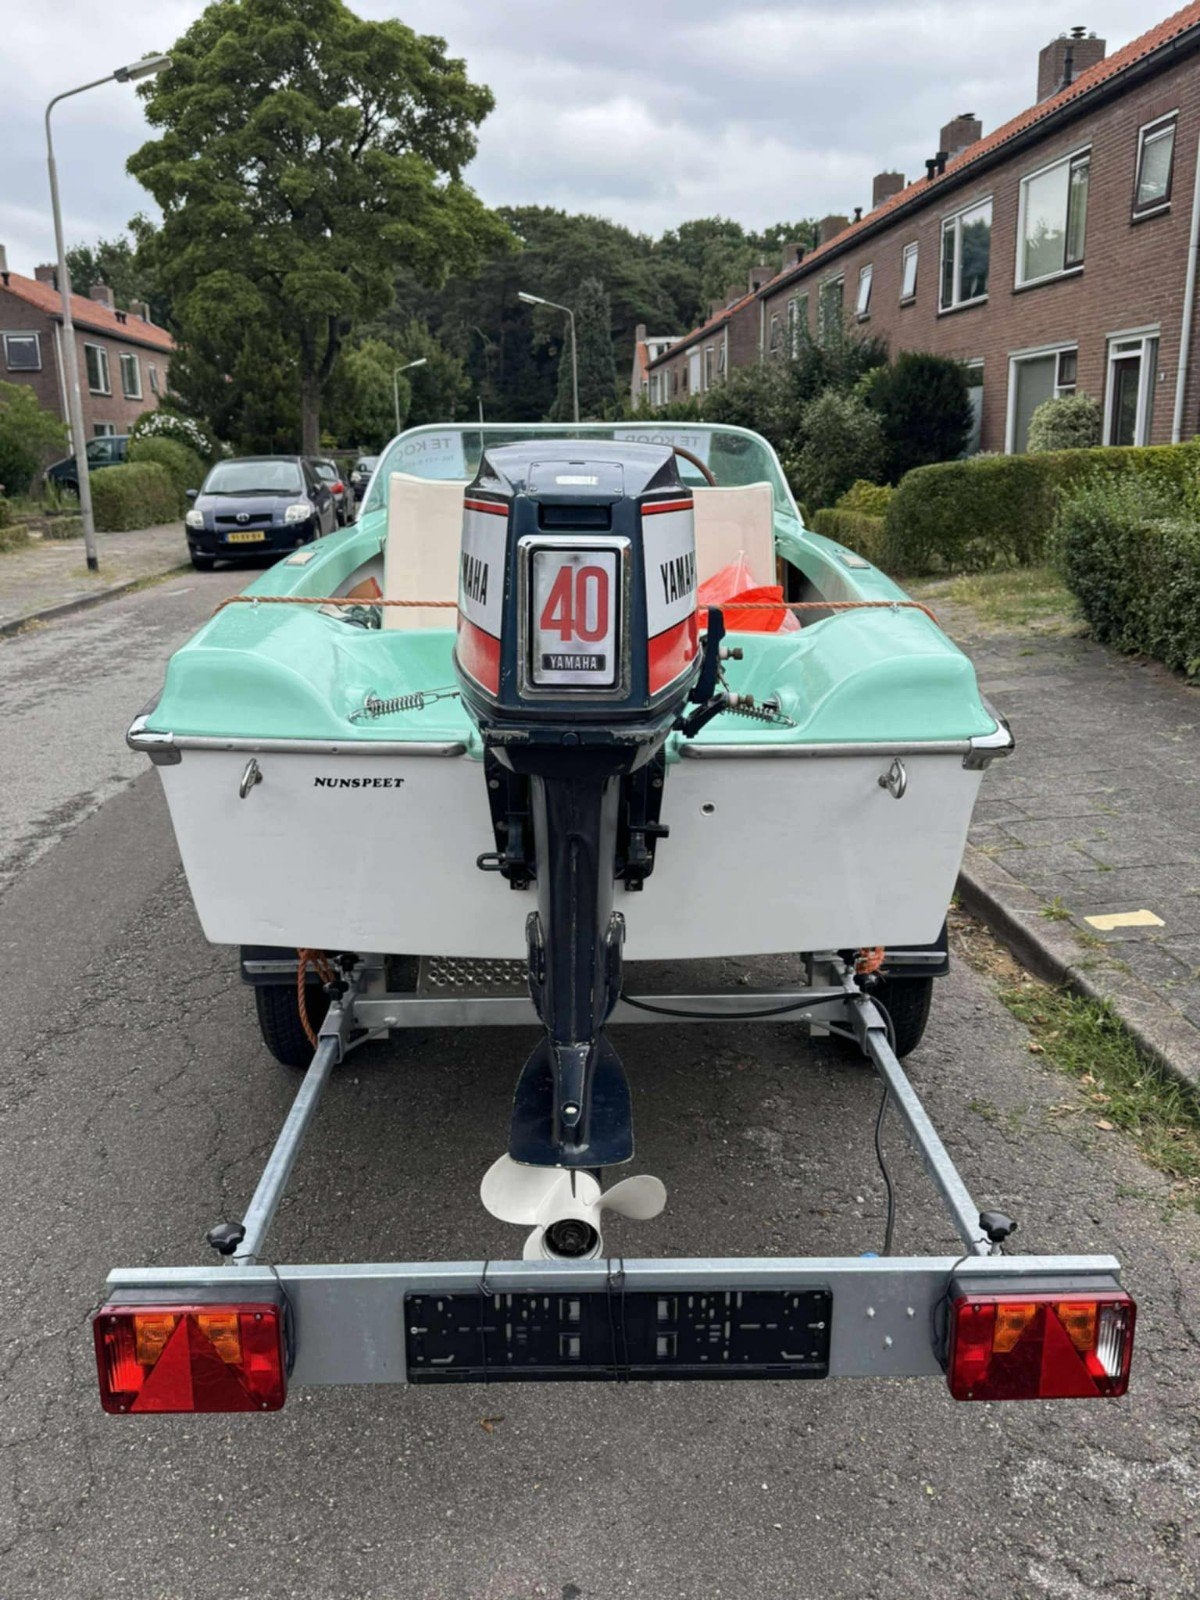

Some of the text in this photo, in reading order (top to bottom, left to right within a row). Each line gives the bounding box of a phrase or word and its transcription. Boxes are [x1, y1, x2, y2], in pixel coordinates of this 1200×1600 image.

[660, 549, 695, 605] YAMAH
[540, 566, 609, 642] 40
[550, 655, 597, 670] YAMAHA
[314, 777, 405, 788] NUNSPEET
